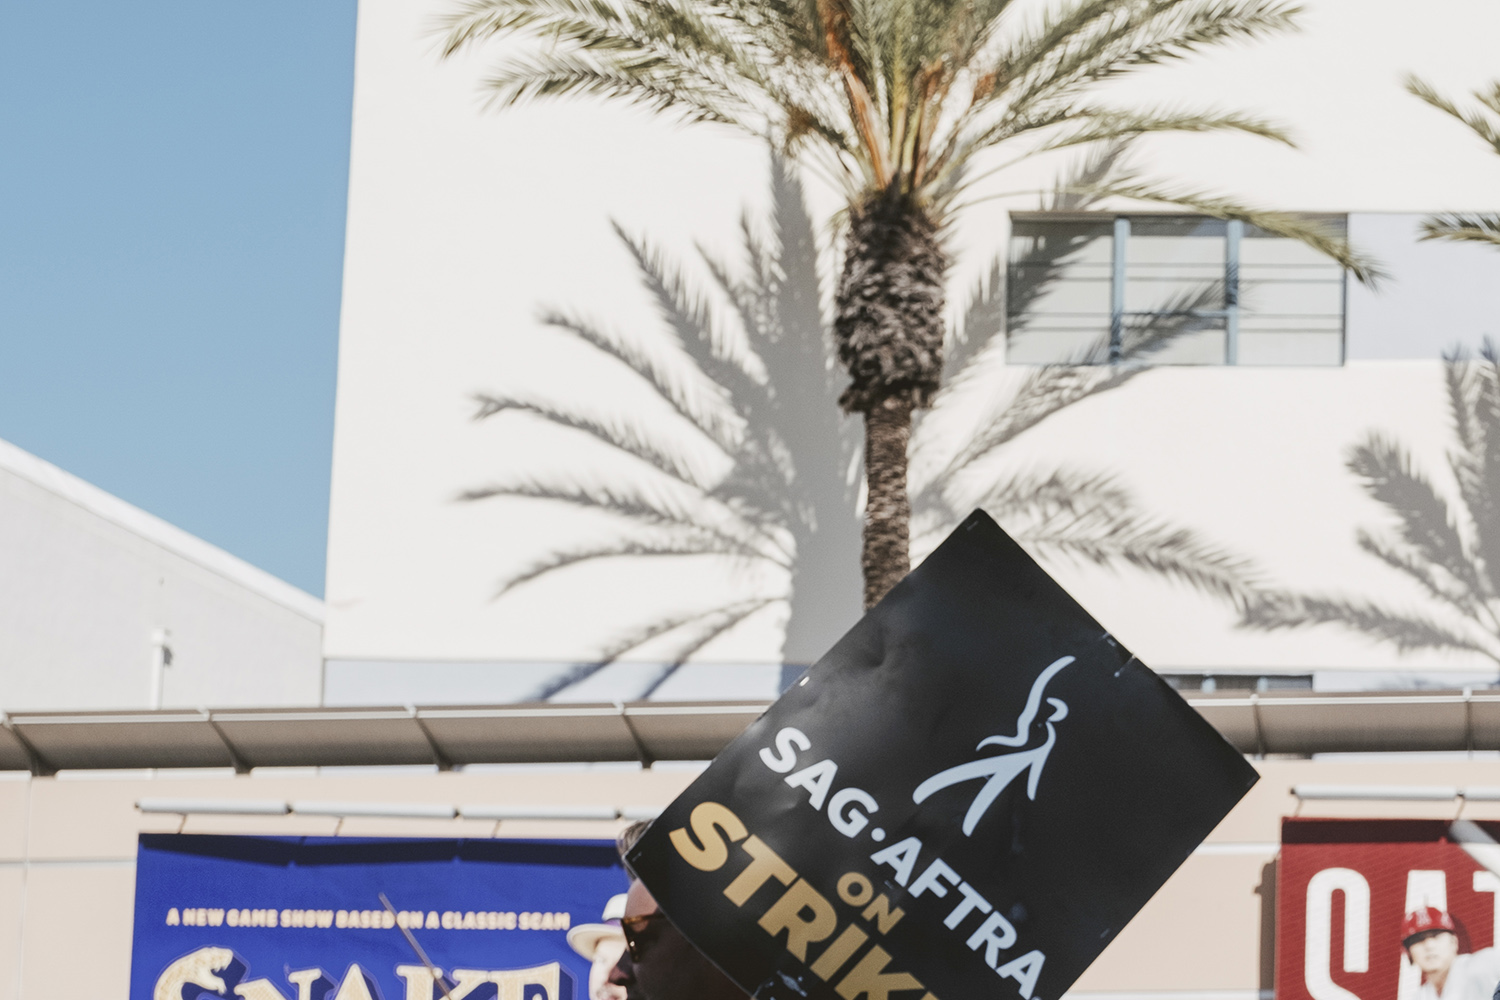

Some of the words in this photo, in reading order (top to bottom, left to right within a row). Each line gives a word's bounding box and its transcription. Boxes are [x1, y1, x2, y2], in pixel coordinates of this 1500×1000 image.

[166, 908, 180, 926] A
[182, 908, 225, 927] NEW
[226, 908, 278, 928] GAME
[280, 909, 334, 929] SHOW
[335, 910, 396, 929] BASED
[397, 911, 424, 929] ON
[425, 911, 440, 929] A
[441, 911, 517, 930] CLASSIC
[518, 912, 571, 931] SCAM
[836, 872, 906, 935] ON
